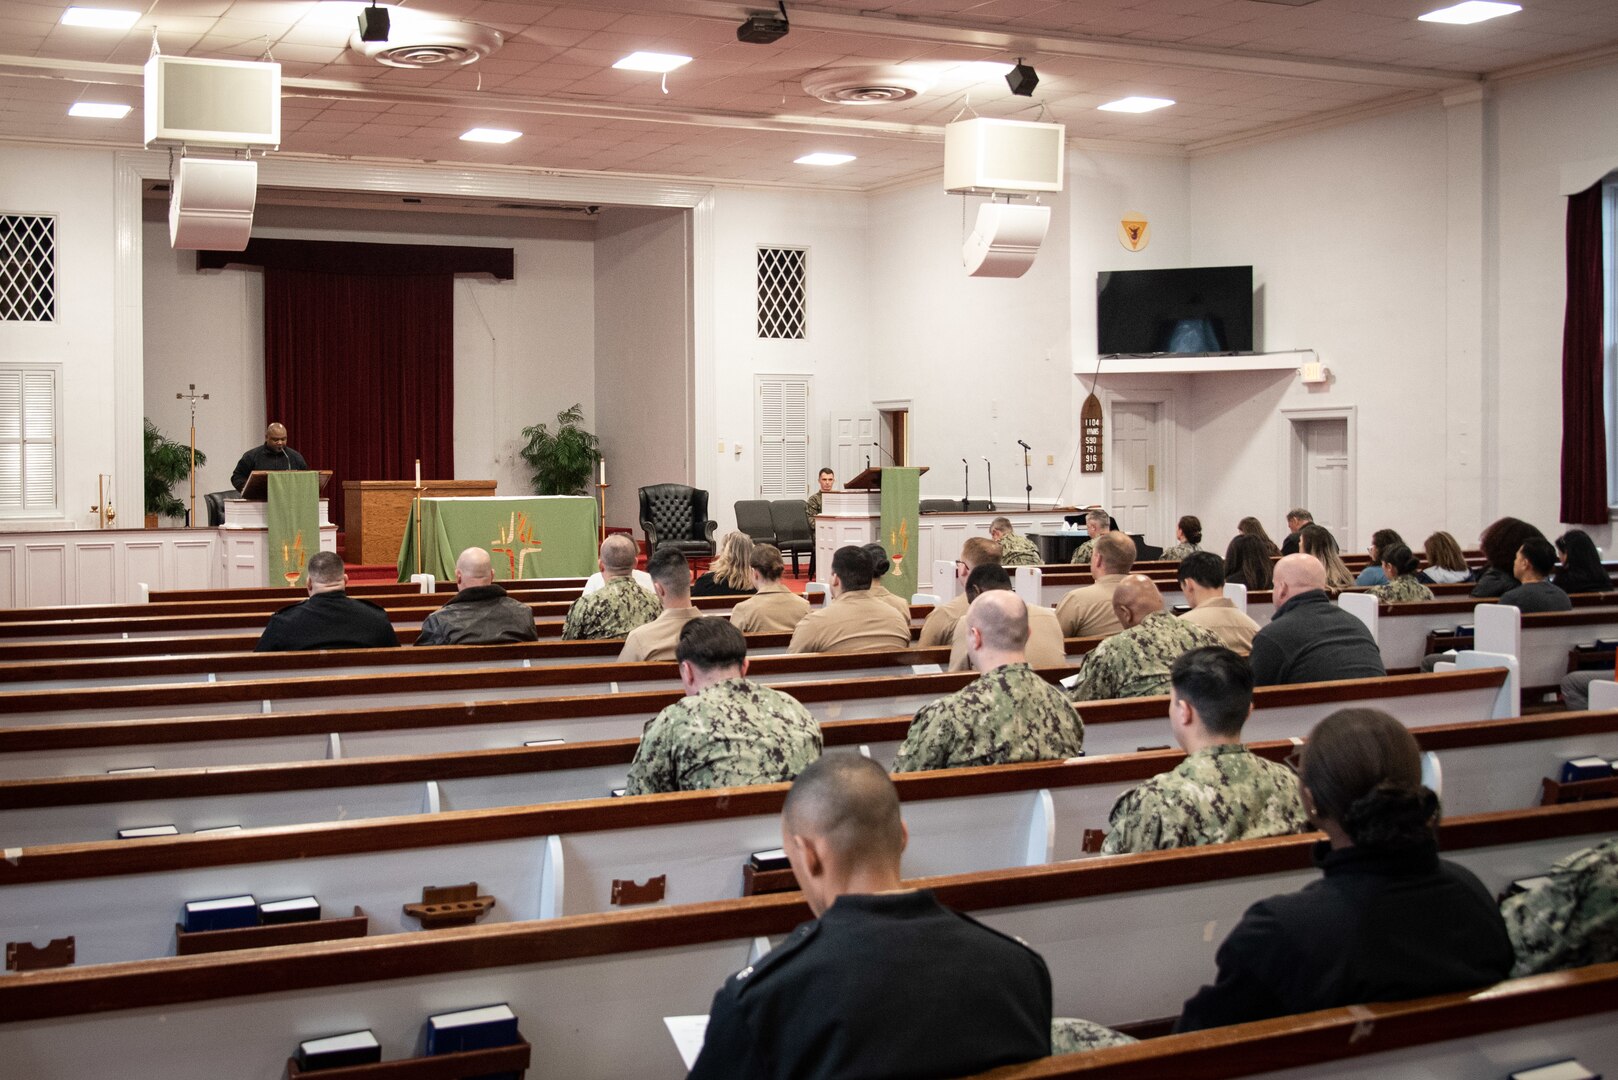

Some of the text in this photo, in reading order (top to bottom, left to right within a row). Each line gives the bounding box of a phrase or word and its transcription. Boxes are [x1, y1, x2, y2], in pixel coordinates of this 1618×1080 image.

[1085, 418, 1100, 426] 1104
[1085, 436, 1097, 444] 590
[1086, 446, 1096, 454] 751
[1085, 454, 1098, 462] 916
[1085, 464, 1097, 472] 807
